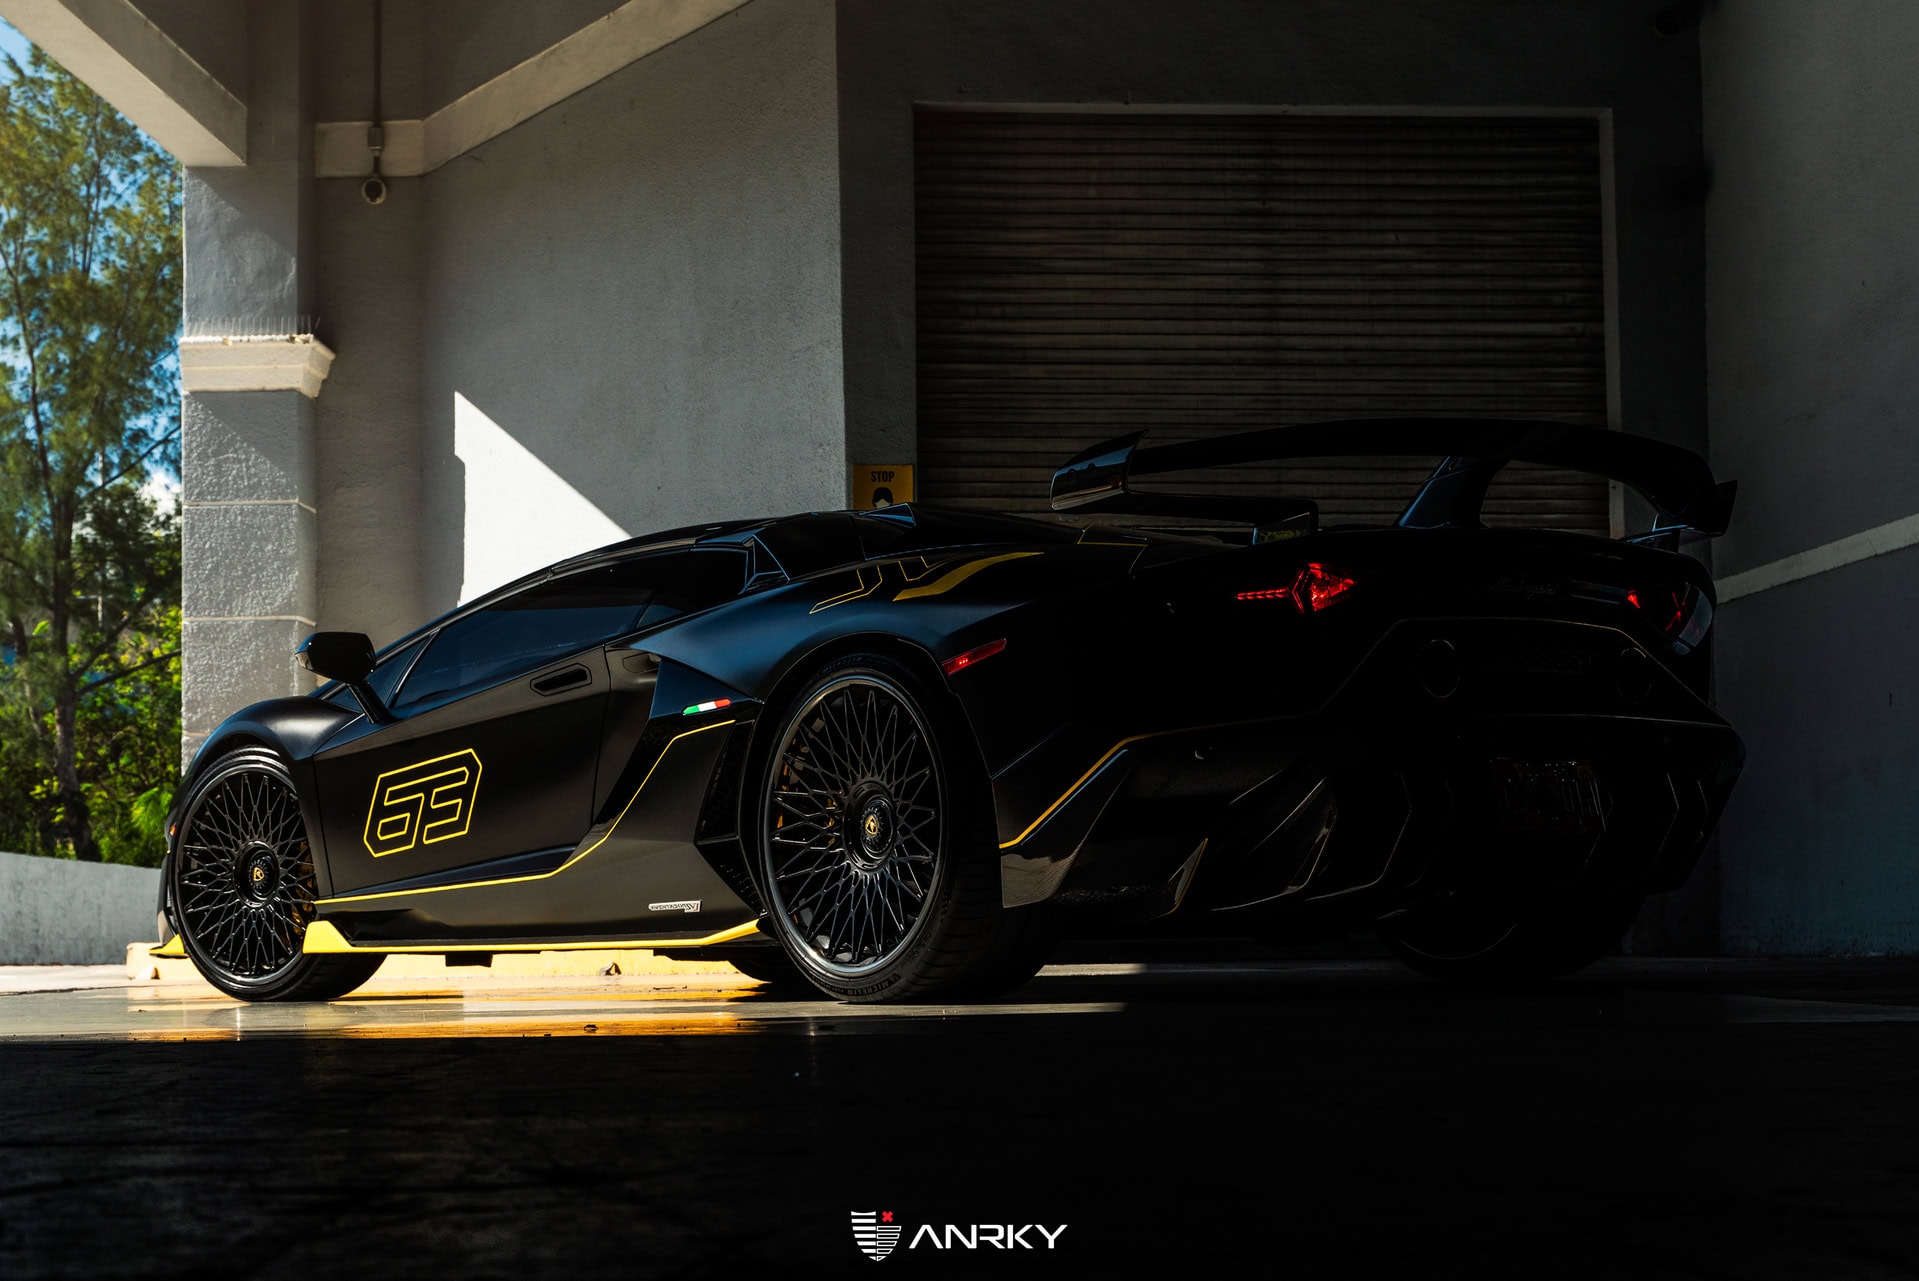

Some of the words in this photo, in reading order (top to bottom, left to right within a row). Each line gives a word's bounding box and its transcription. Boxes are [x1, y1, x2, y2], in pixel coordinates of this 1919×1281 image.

[871, 470, 895, 482] STOP
[363, 747, 483, 858] 63
[847, 979, 890, 996] MICHELIN
